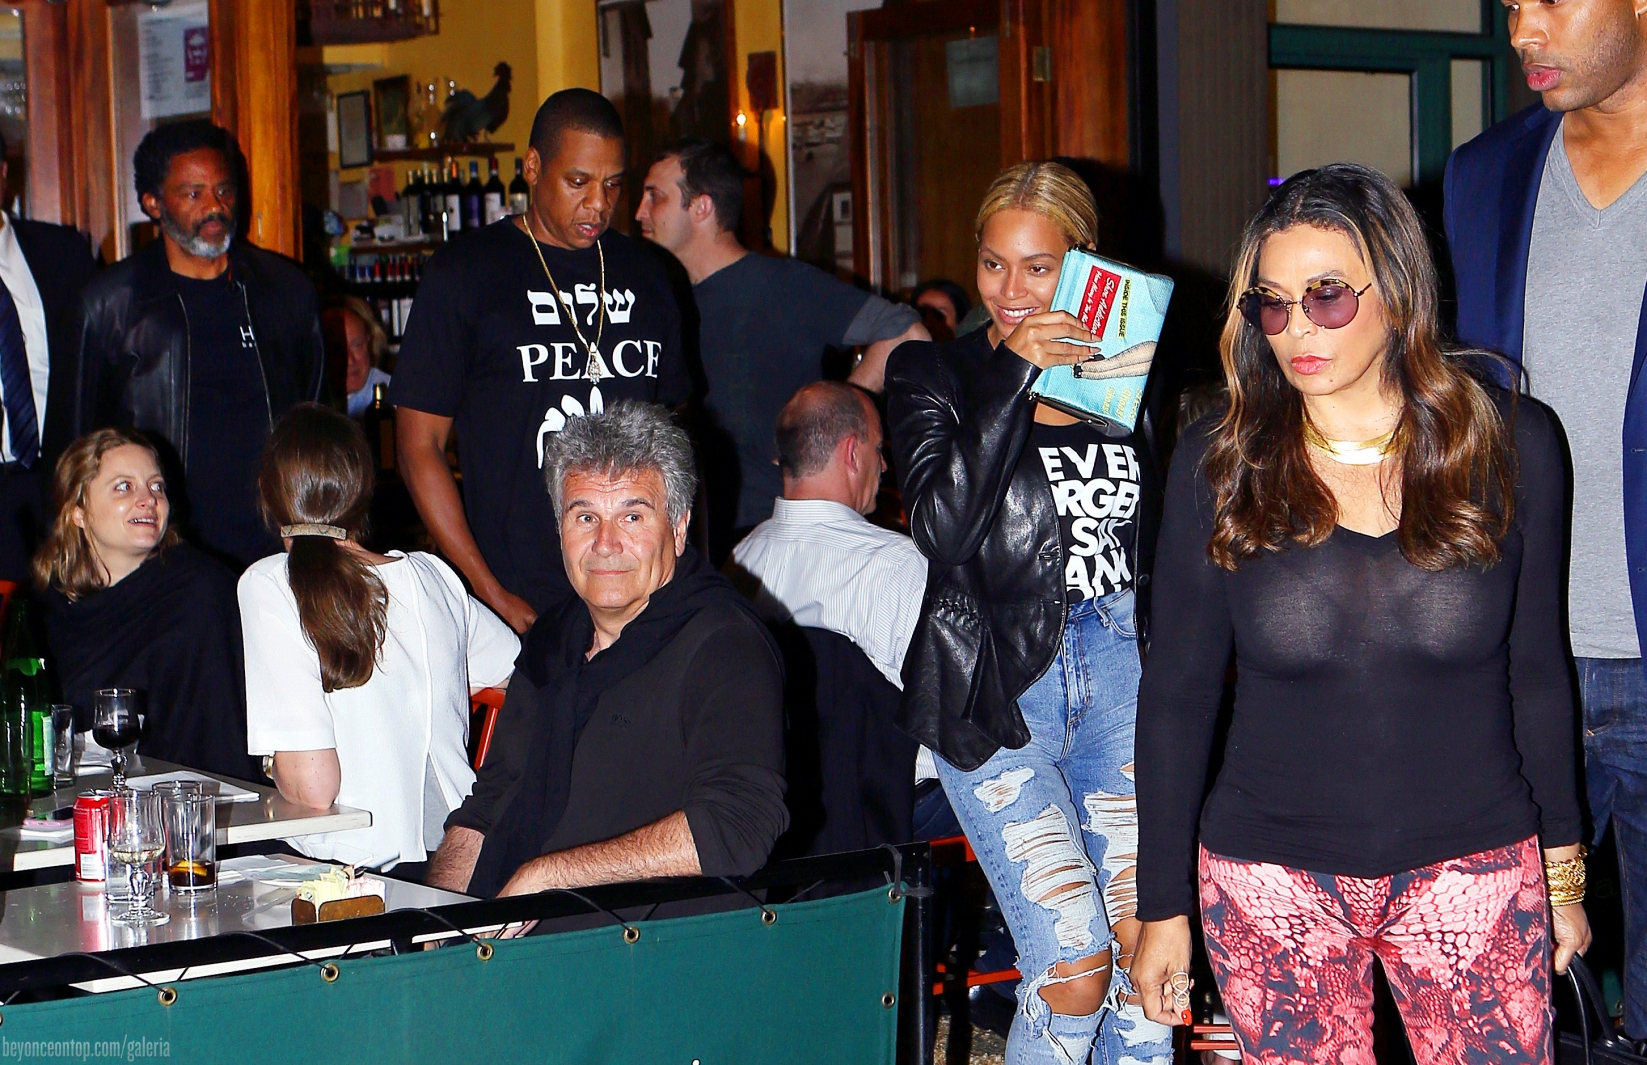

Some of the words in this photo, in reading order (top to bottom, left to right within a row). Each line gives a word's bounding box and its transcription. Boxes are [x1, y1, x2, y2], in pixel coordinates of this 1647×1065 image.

[527, 283, 635, 326] שלום
[1102, 277, 1114, 298] Shoe
[1090, 298, 1107, 334] Addiction
[516, 340, 661, 383] PEACE
